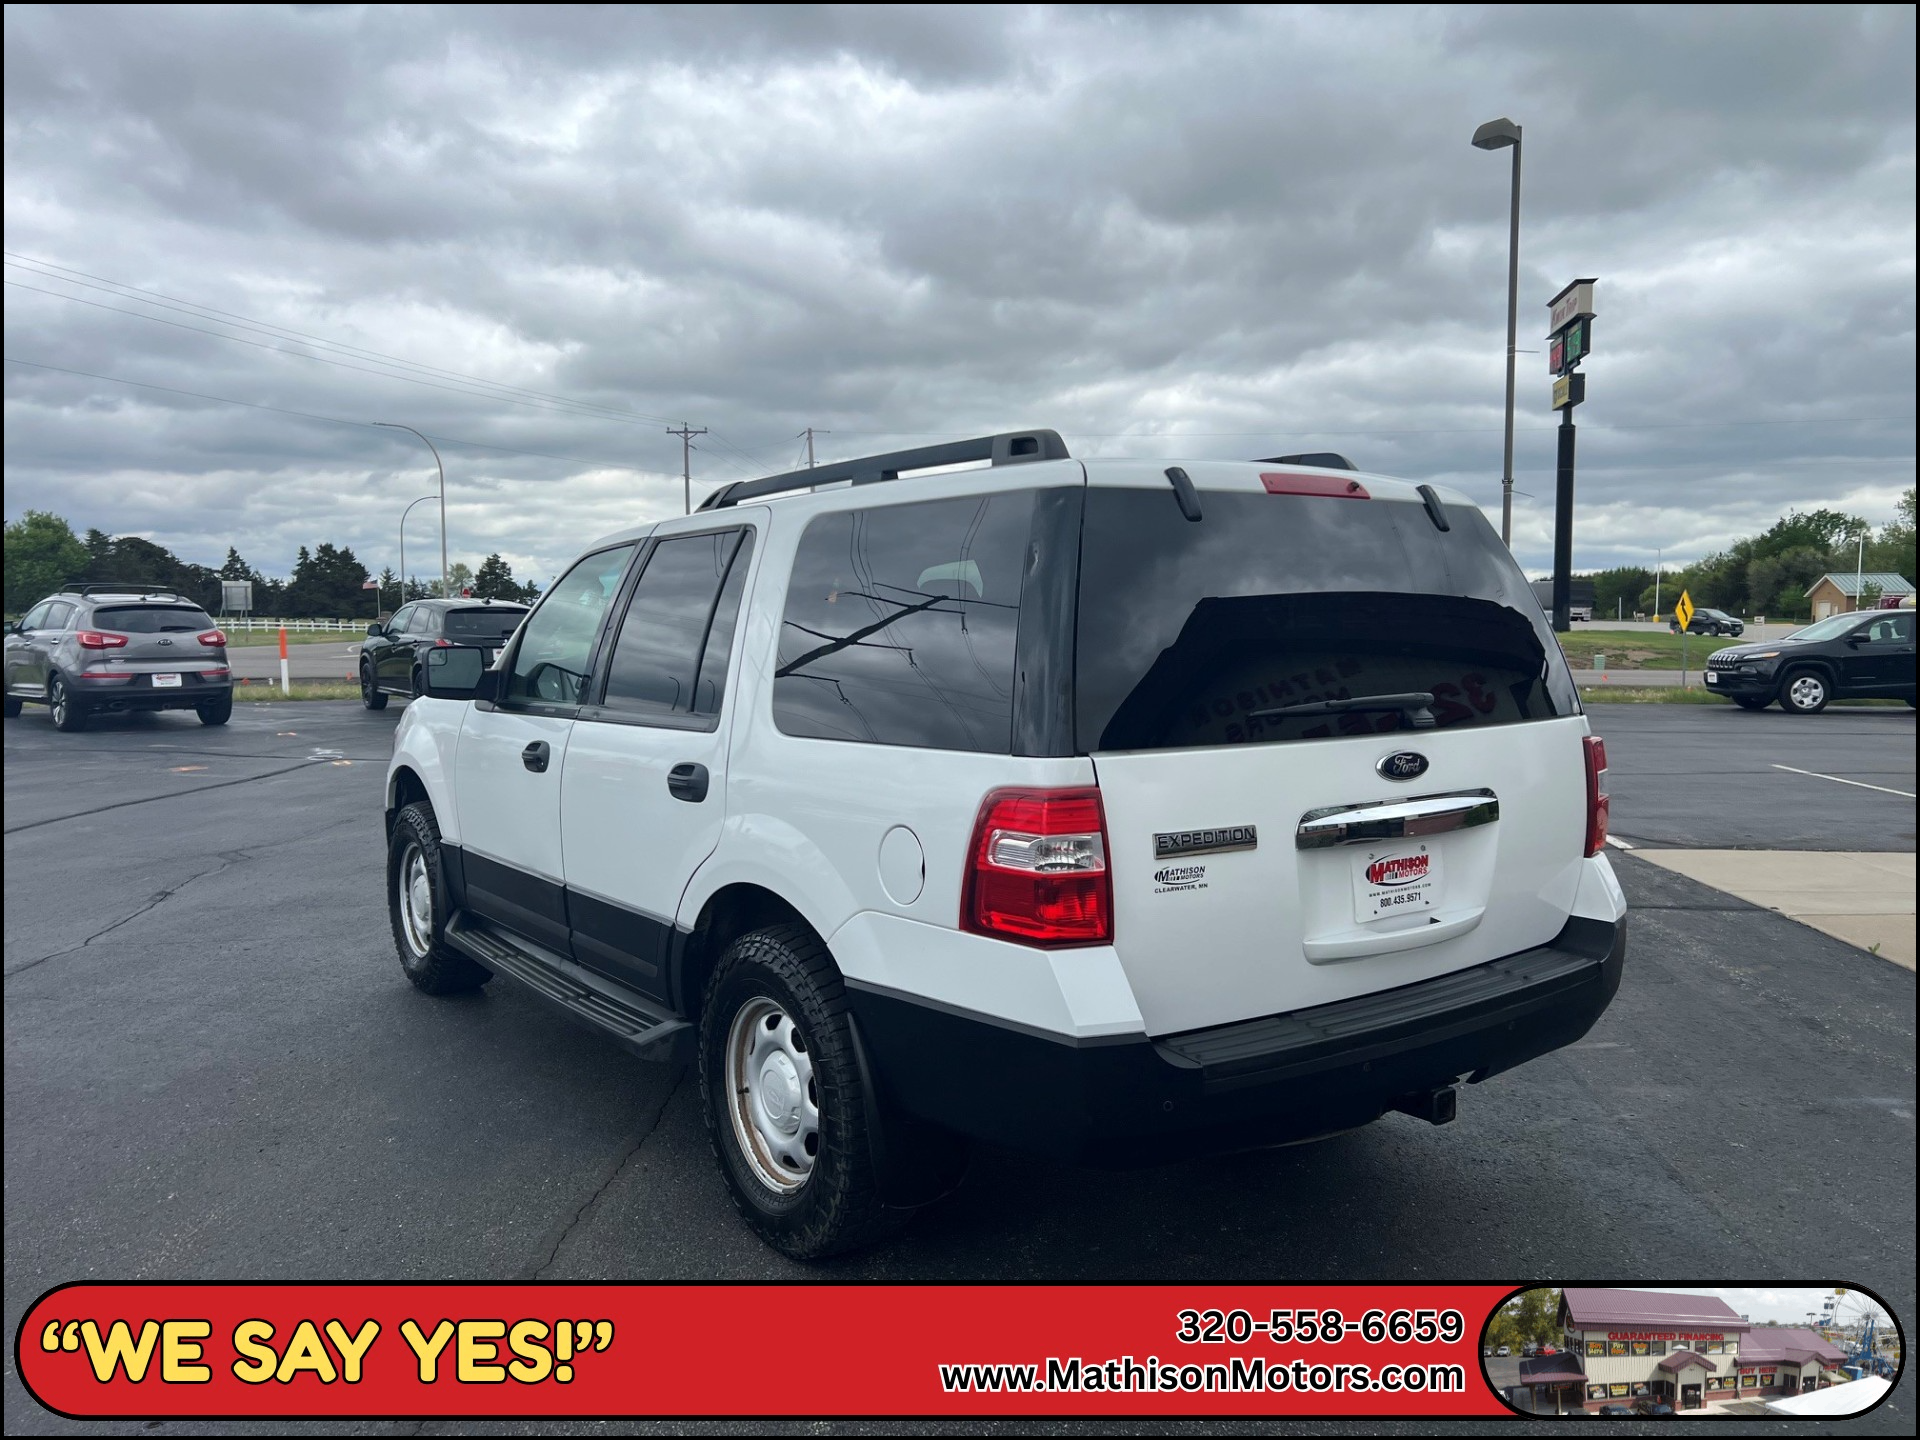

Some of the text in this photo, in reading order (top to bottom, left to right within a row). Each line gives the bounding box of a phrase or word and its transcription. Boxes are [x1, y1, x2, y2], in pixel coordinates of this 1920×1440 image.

[1392, 753, 1421, 775] Ford
[1156, 827, 1256, 849] EXPEDITION
[1157, 865, 1206, 883] MATHISON
[1180, 873, 1204, 881] MOTORS
[1368, 854, 1429, 883] MATHISON
[1398, 866, 1428, 879] MOTORS
[1154, 884, 1197, 894] CLEARWATER,
[1380, 892, 1421, 908] 800.435.9571
